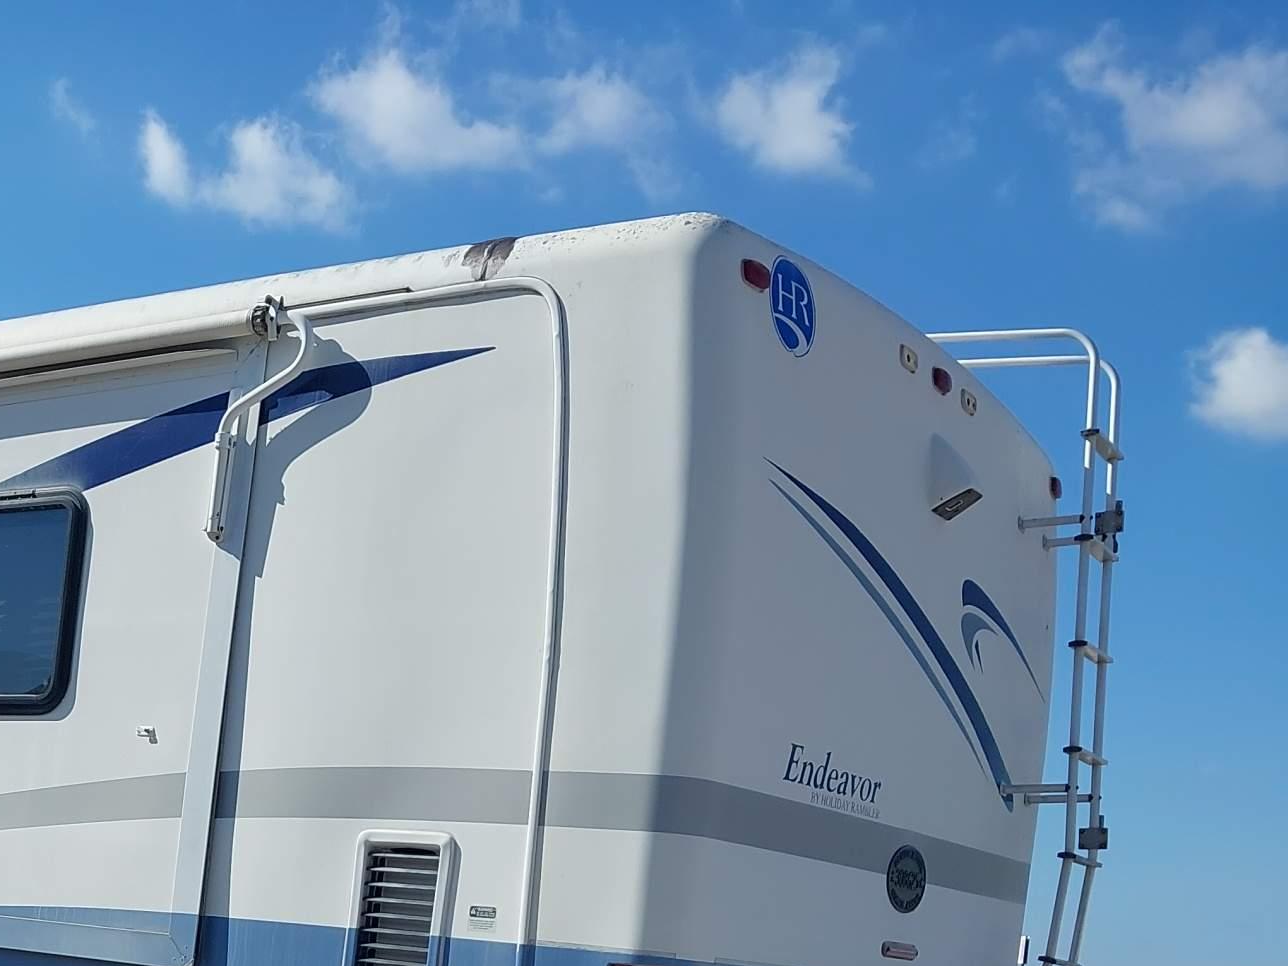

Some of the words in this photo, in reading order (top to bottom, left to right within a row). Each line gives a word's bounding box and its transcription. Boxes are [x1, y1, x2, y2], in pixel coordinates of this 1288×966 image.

[777, 273, 810, 326] HR
[782, 743, 881, 803] Endeavor
[820, 795, 851, 812] HOLIDAY
